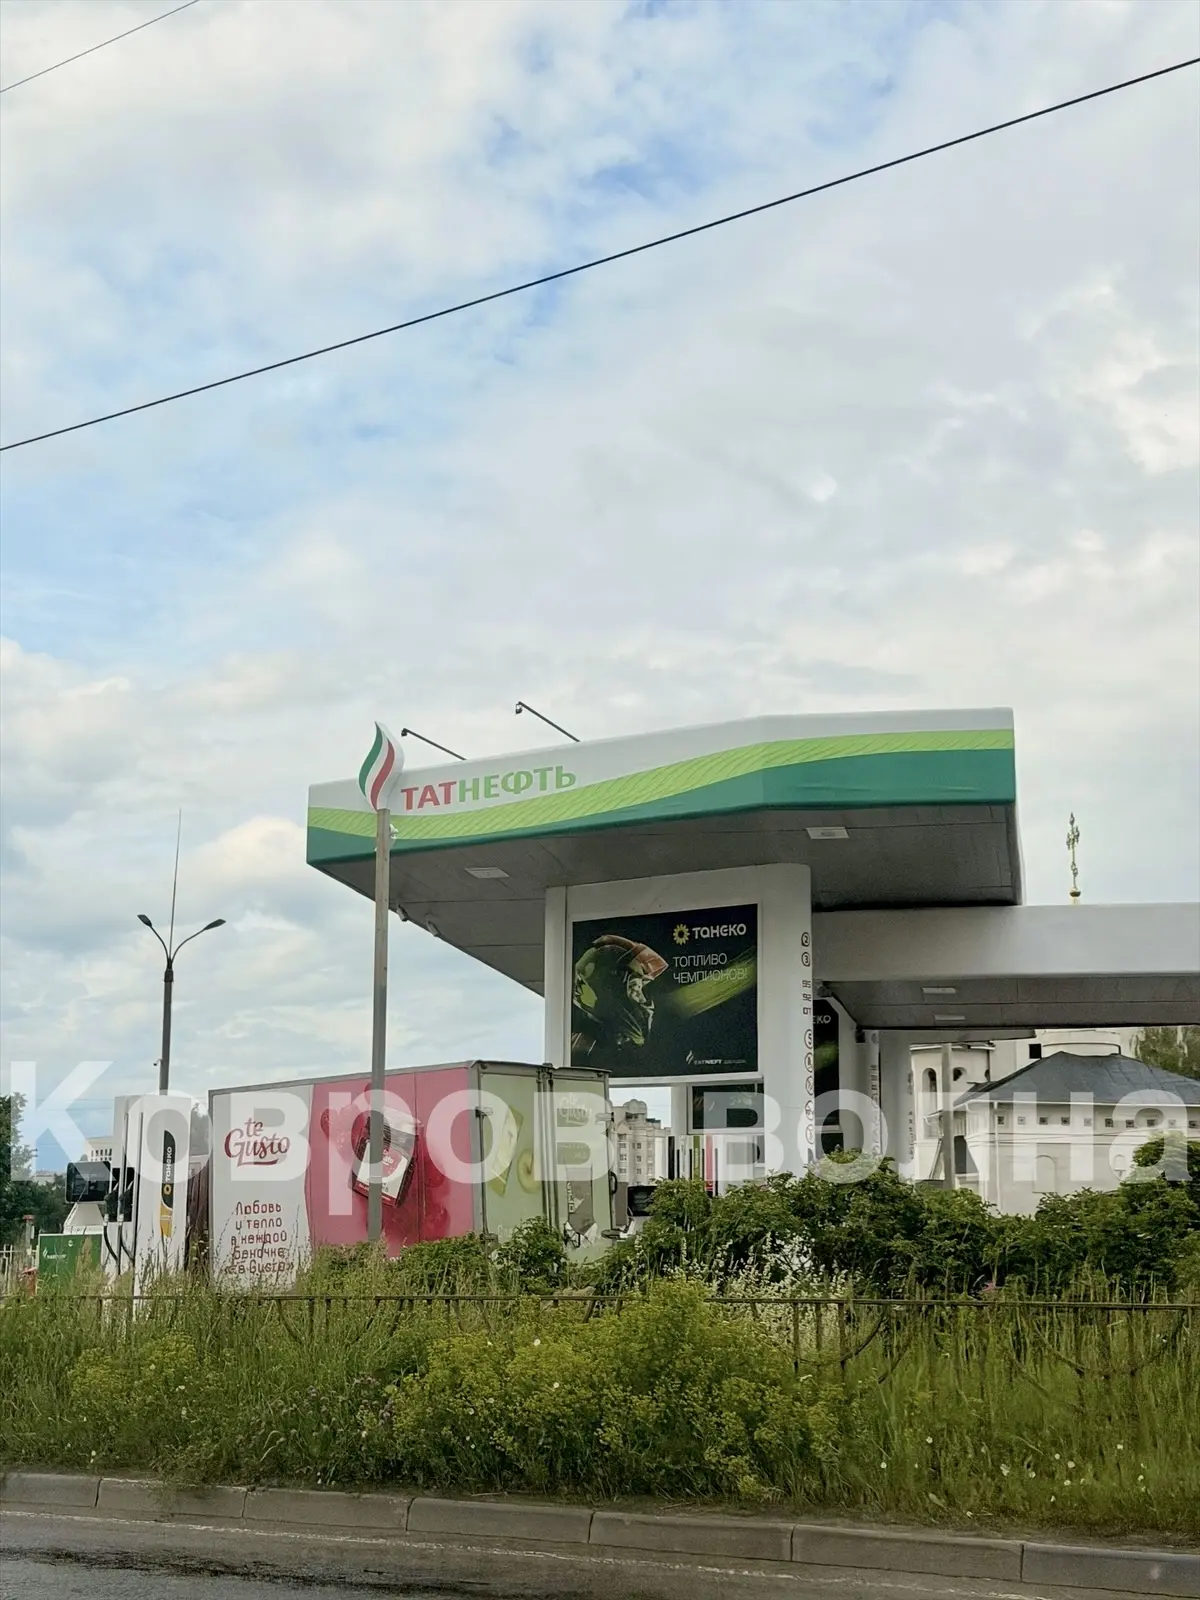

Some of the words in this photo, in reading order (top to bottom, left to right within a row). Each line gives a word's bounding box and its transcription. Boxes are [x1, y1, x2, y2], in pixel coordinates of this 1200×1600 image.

[401, 766, 576, 811] ТАТНЕФТЬ
[672, 952, 728, 968] ТОПЛИВО
[673, 968, 748, 983] ЧЕМПИОНОВ!
[244, 1117, 264, 1138] te
[224, 1128, 291, 1168] Gusto
[235, 1200, 282, 1215] Любовь
[235, 1220, 242, 1230] и
[246, 1217, 282, 1229] тепло
[241, 1230, 287, 1245] каждой
